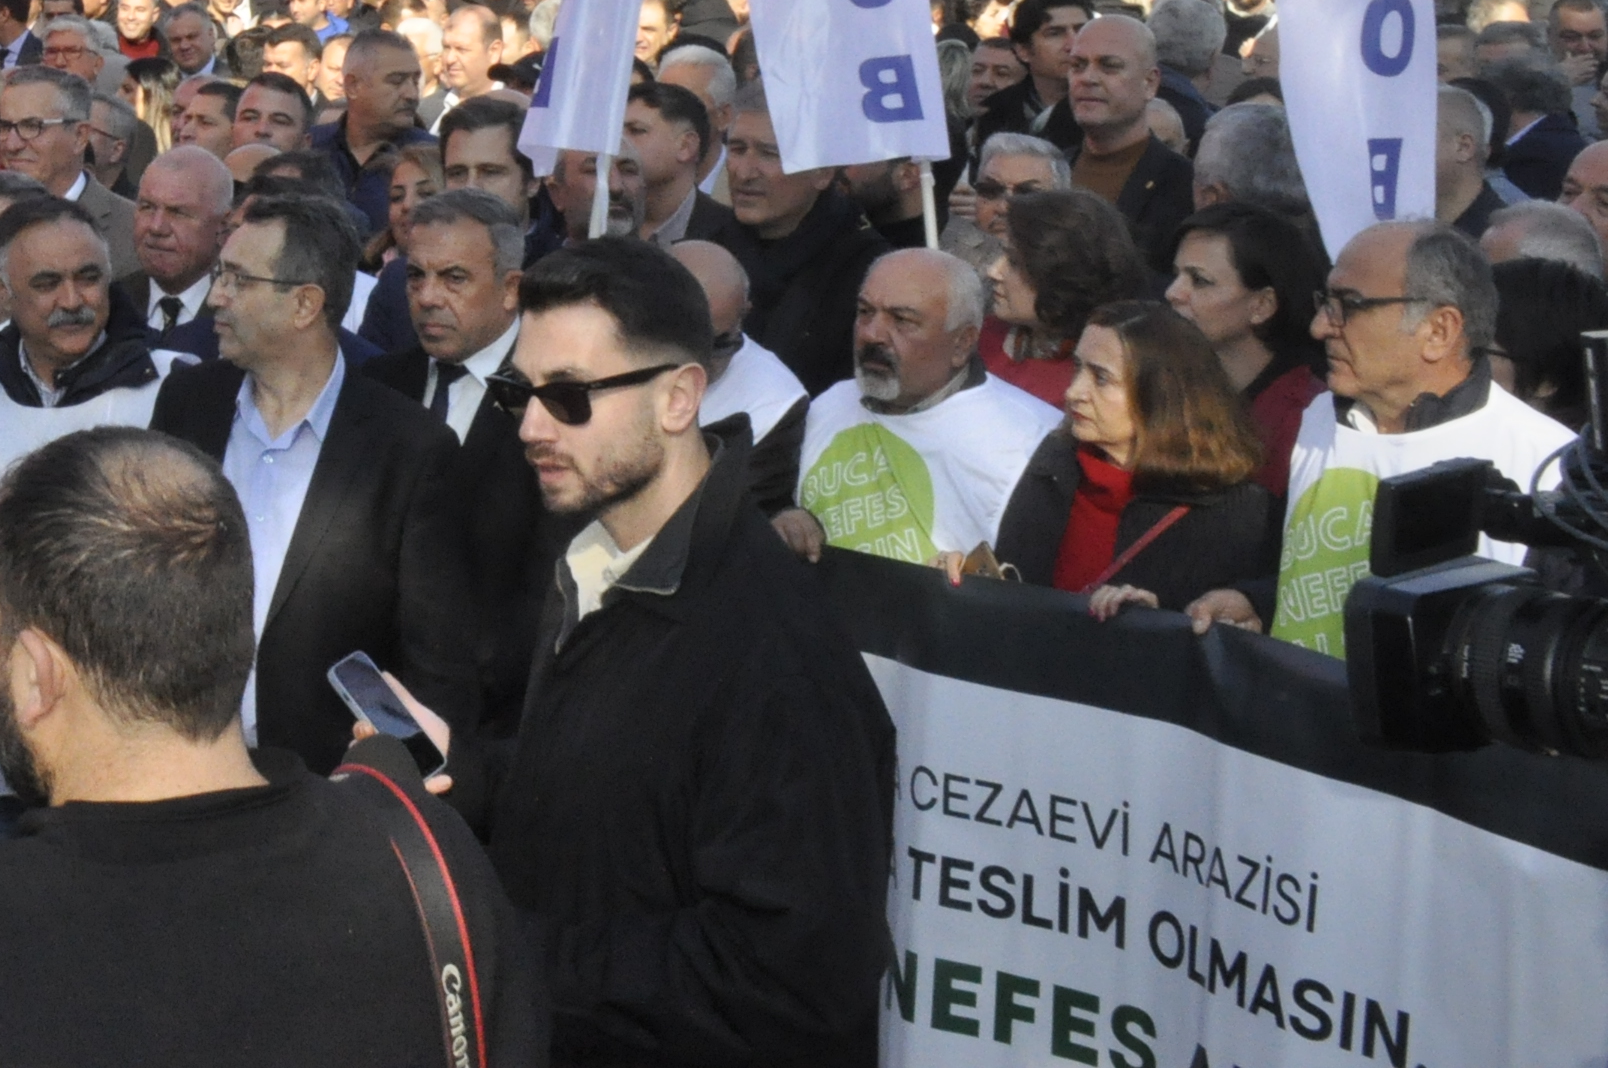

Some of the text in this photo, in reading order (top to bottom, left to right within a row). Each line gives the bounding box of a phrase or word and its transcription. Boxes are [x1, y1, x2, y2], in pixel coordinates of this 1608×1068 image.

[906, 845, 1127, 951] TESLİM
[909, 764, 1132, 858] CEZAEVİ
[1149, 821, 1321, 934] ARAZİSİ
[885, 949, 1157, 1068] NEFES
